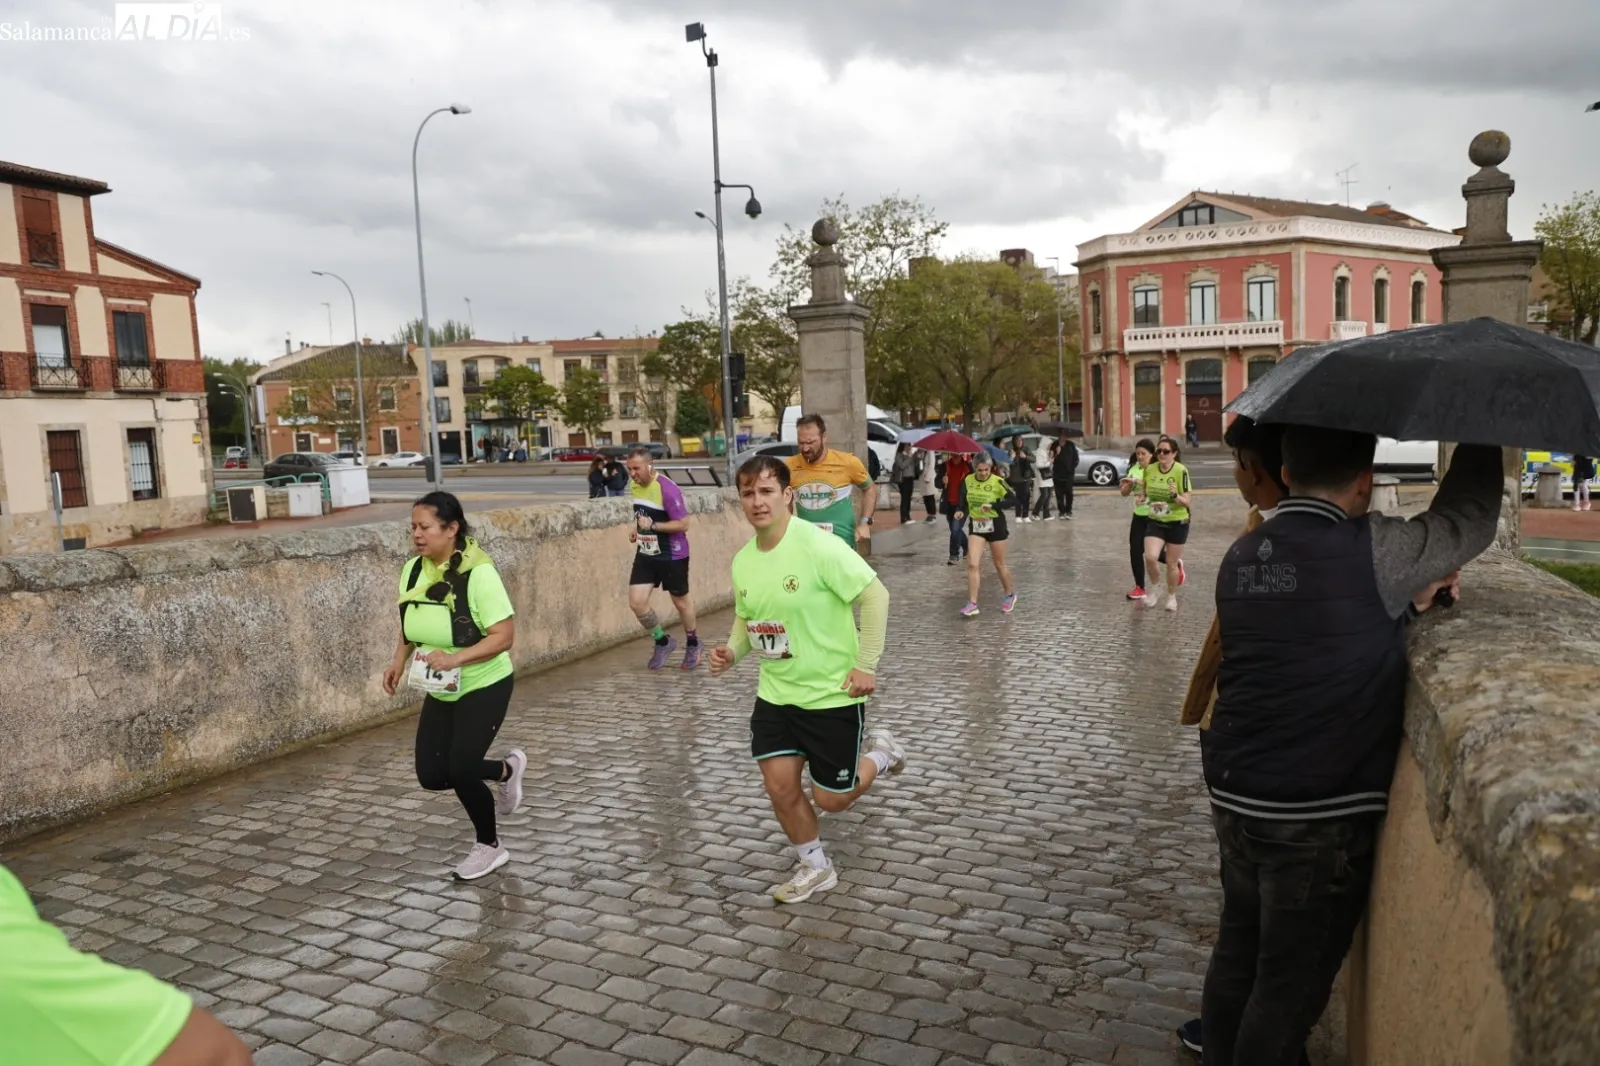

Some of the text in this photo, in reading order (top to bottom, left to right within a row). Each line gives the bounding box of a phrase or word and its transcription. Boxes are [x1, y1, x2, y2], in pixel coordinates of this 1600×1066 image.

[1236, 563, 1297, 593] PLNS
[758, 633, 776, 650] 17
[425, 665, 443, 681] 14
